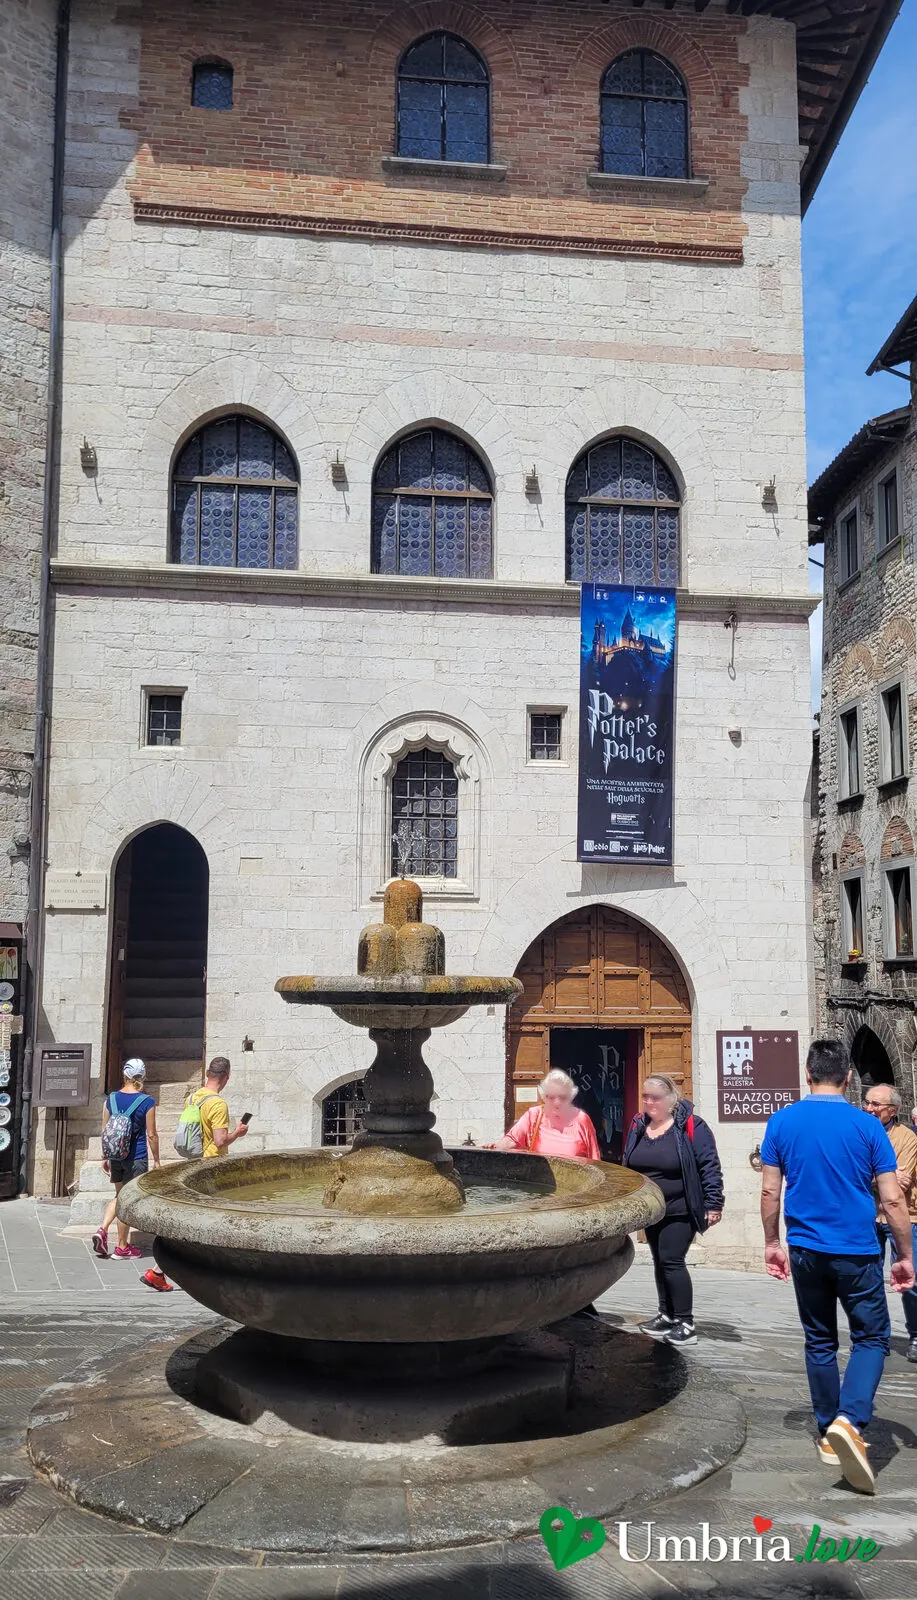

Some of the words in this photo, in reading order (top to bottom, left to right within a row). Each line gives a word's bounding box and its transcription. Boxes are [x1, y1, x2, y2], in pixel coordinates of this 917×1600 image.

[587, 689, 657, 749] Potter's
[606, 792, 645, 806] Hogwarts
[723, 1092, 771, 1102] PALAZZO
[774, 1092, 794, 1102] DEL
